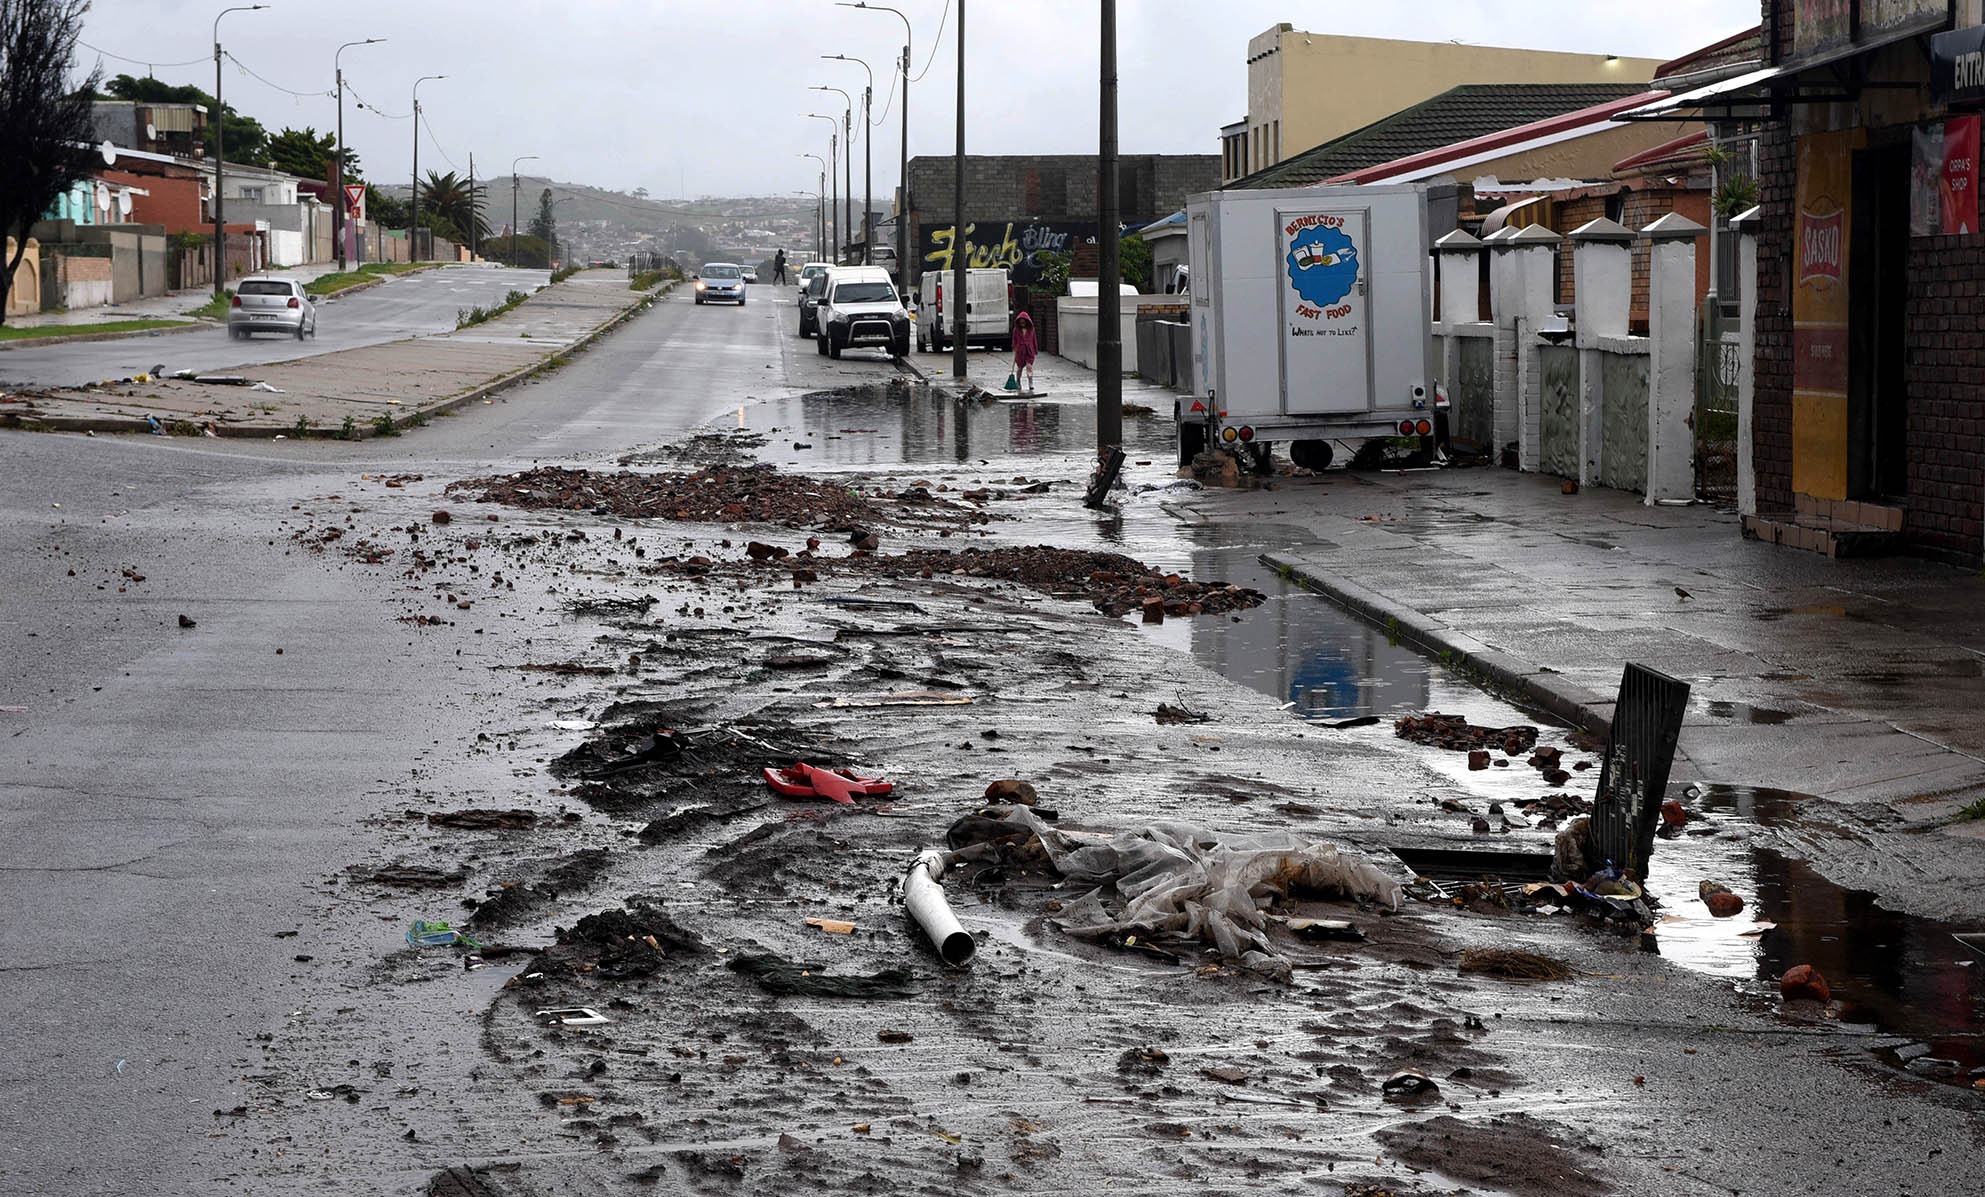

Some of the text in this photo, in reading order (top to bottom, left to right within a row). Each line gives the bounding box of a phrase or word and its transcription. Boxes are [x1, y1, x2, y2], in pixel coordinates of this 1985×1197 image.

[1951, 177, 1968, 191] SHOP
[1285, 215, 1344, 236] BERNICIO'S
[1804, 224, 1839, 268] SASKO
[1296, 304, 1352, 320] FAST FOOD
